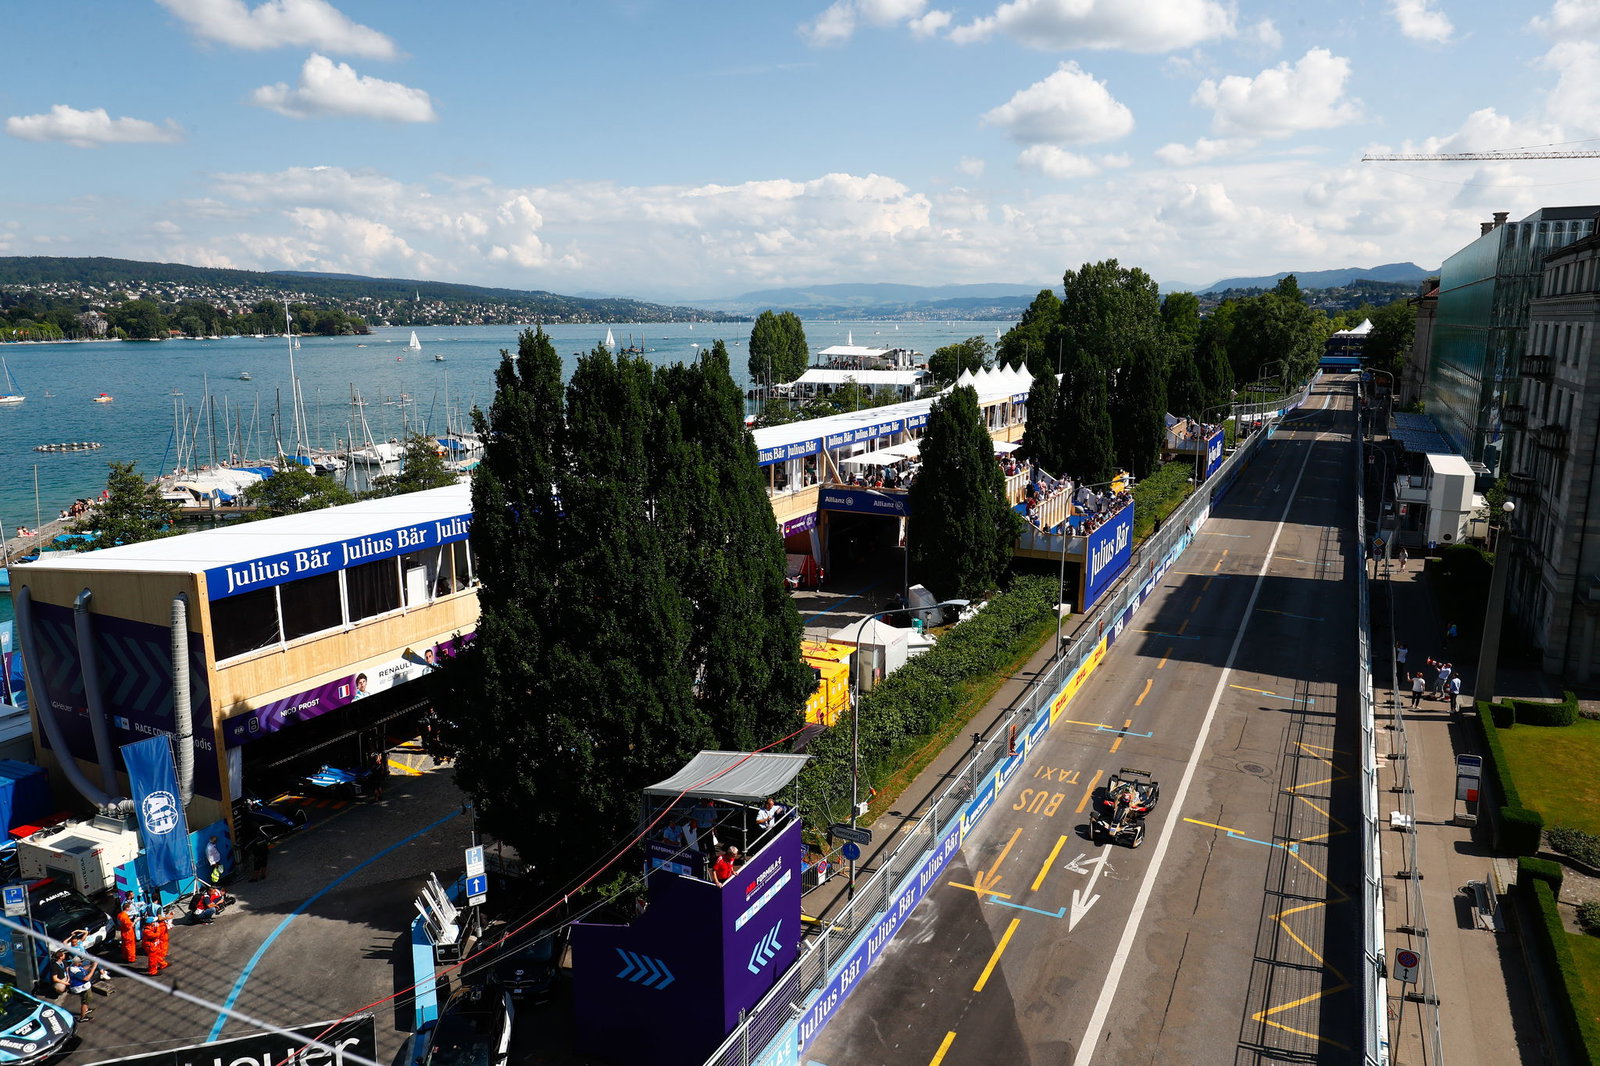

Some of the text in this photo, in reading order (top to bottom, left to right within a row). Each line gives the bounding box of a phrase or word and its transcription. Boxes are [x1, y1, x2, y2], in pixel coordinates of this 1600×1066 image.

[758, 441, 817, 462] lius Bär Julius Bär
[825, 496, 894, 508] Allianz Allianz
[226, 517, 472, 593] Julius Bär Julius Bär Juliu
[1090, 521, 1130, 587] Julius Bär
[379, 662, 413, 677] RENAULT
[248, 717, 259, 733] 8
[280, 706, 297, 717] NICO
[298, 698, 320, 711] PROST
[134, 722, 152, 736] RACE
[193, 737, 212, 751] odis
[1033, 765, 1080, 785] TAXI
[1013, 788, 1066, 817] BUS
[920, 830, 959, 896] Julius Bär
[11, 889, 17, 897] P
[867, 887, 917, 966] Julius Bär
[797, 956, 862, 1052] Julius Bär
[0, 1039, 24, 1050] llianz
